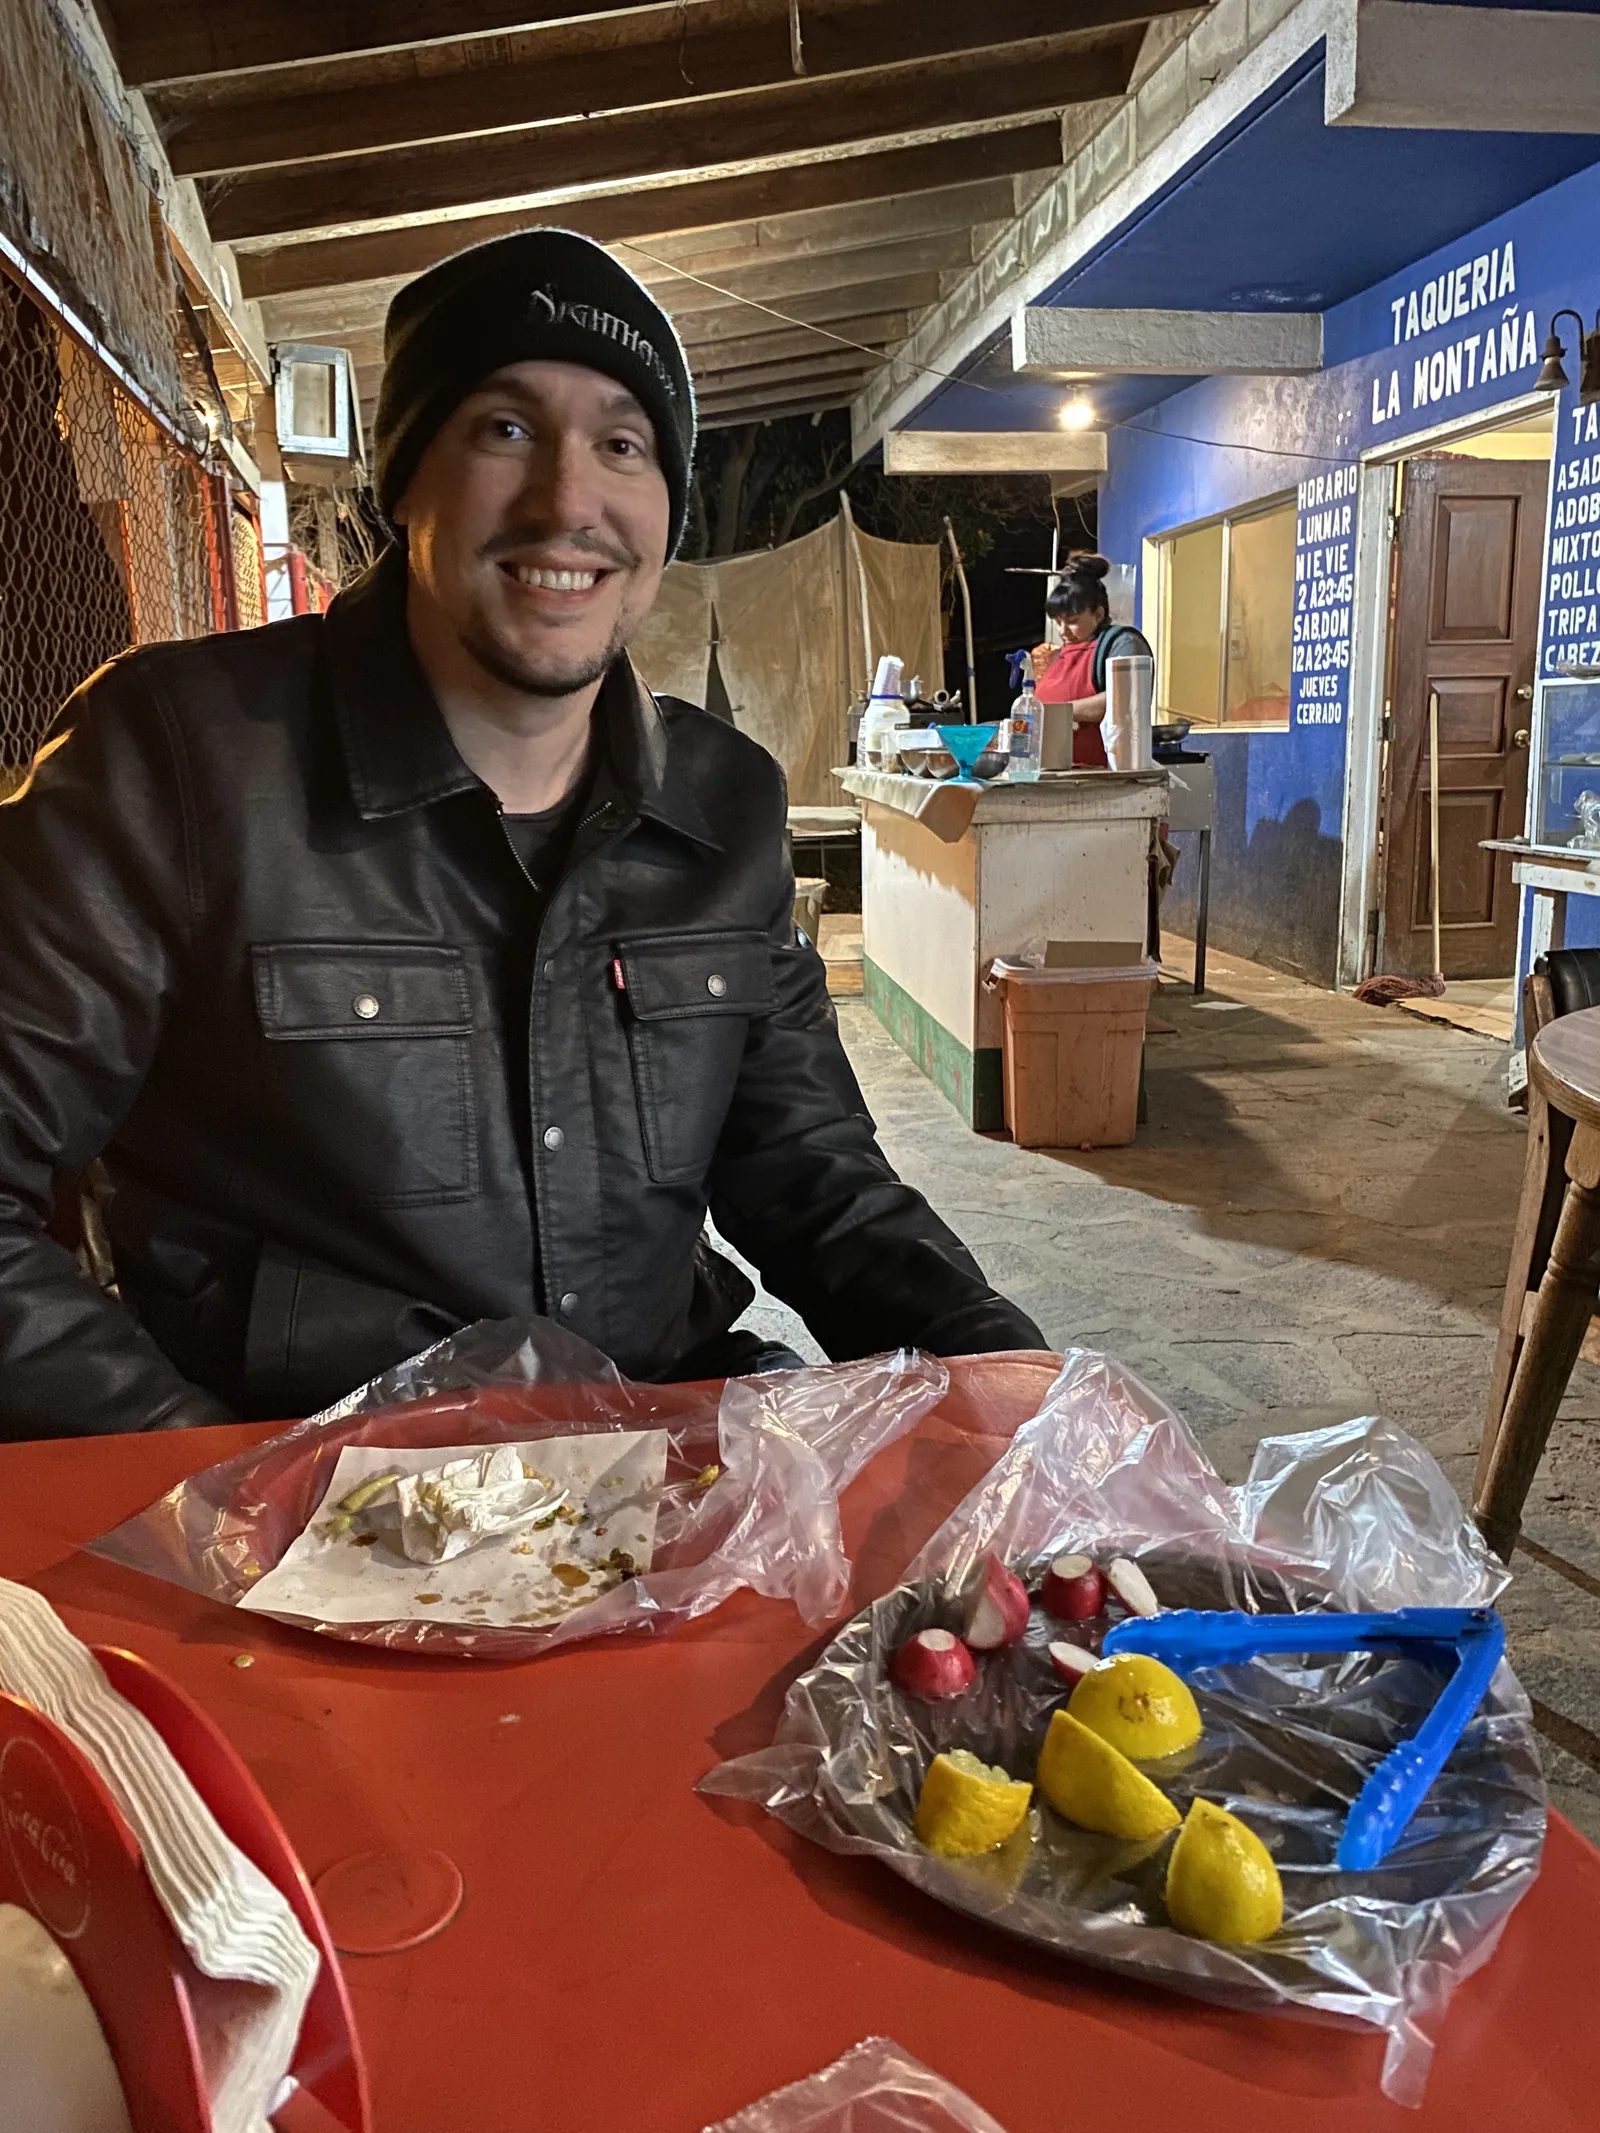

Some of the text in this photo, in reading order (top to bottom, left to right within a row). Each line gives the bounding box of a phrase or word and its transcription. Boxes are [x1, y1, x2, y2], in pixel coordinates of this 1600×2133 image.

[1391, 240, 1516, 346] TAQUERIA
[1372, 303, 1538, 425] LA MONTAÑA
[1297, 465, 1357, 511] HORARIO
[1548, 604, 1597, 637] TRIPA
[1299, 674, 1339, 698] JUEVES
[1296, 702, 1342, 725] CERRADO
